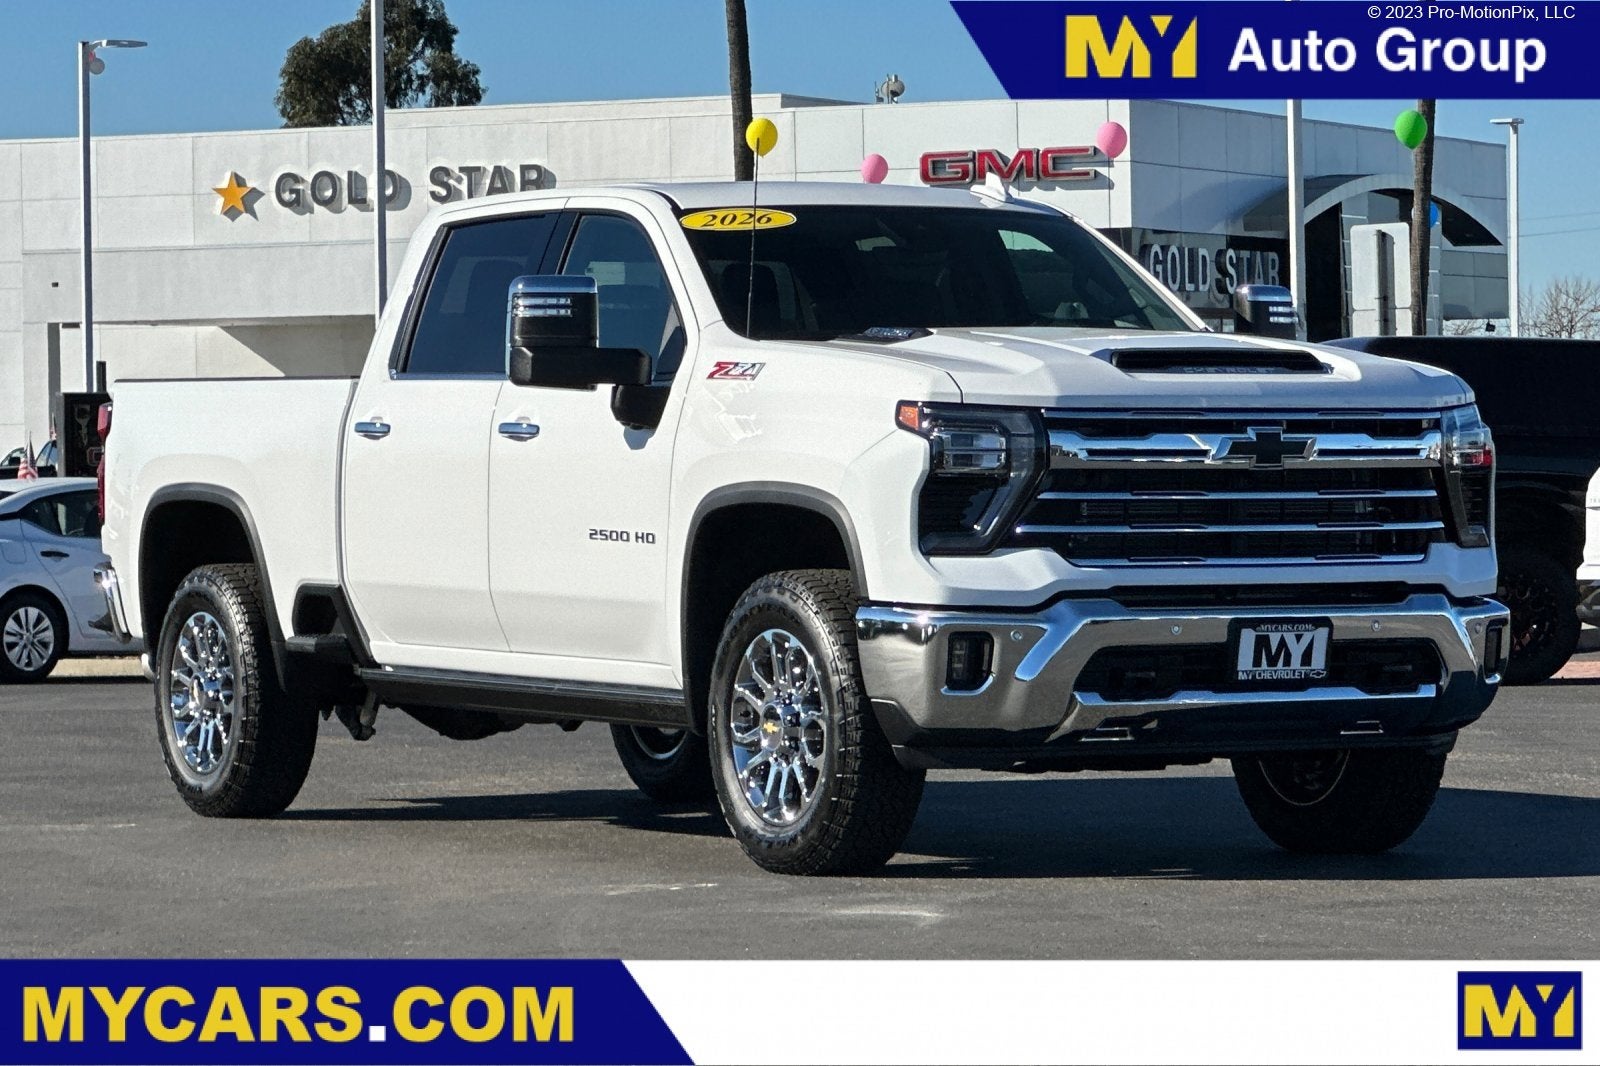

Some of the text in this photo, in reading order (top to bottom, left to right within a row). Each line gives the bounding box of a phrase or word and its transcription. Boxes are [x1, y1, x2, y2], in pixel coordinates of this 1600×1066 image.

[919, 145, 1095, 185] GMC
[274, 164, 546, 208] GOLD STAR
[700, 212, 773, 228] 2026
[1149, 243, 1280, 295] GOLD STAR
[706, 361, 766, 381] Z71
[588, 528, 656, 545] 2500 HD
[1259, 623, 1313, 632] MYCARS.COM
[1252, 633, 1315, 668] MY
[1255, 669, 1306, 680] CHEVROLET
